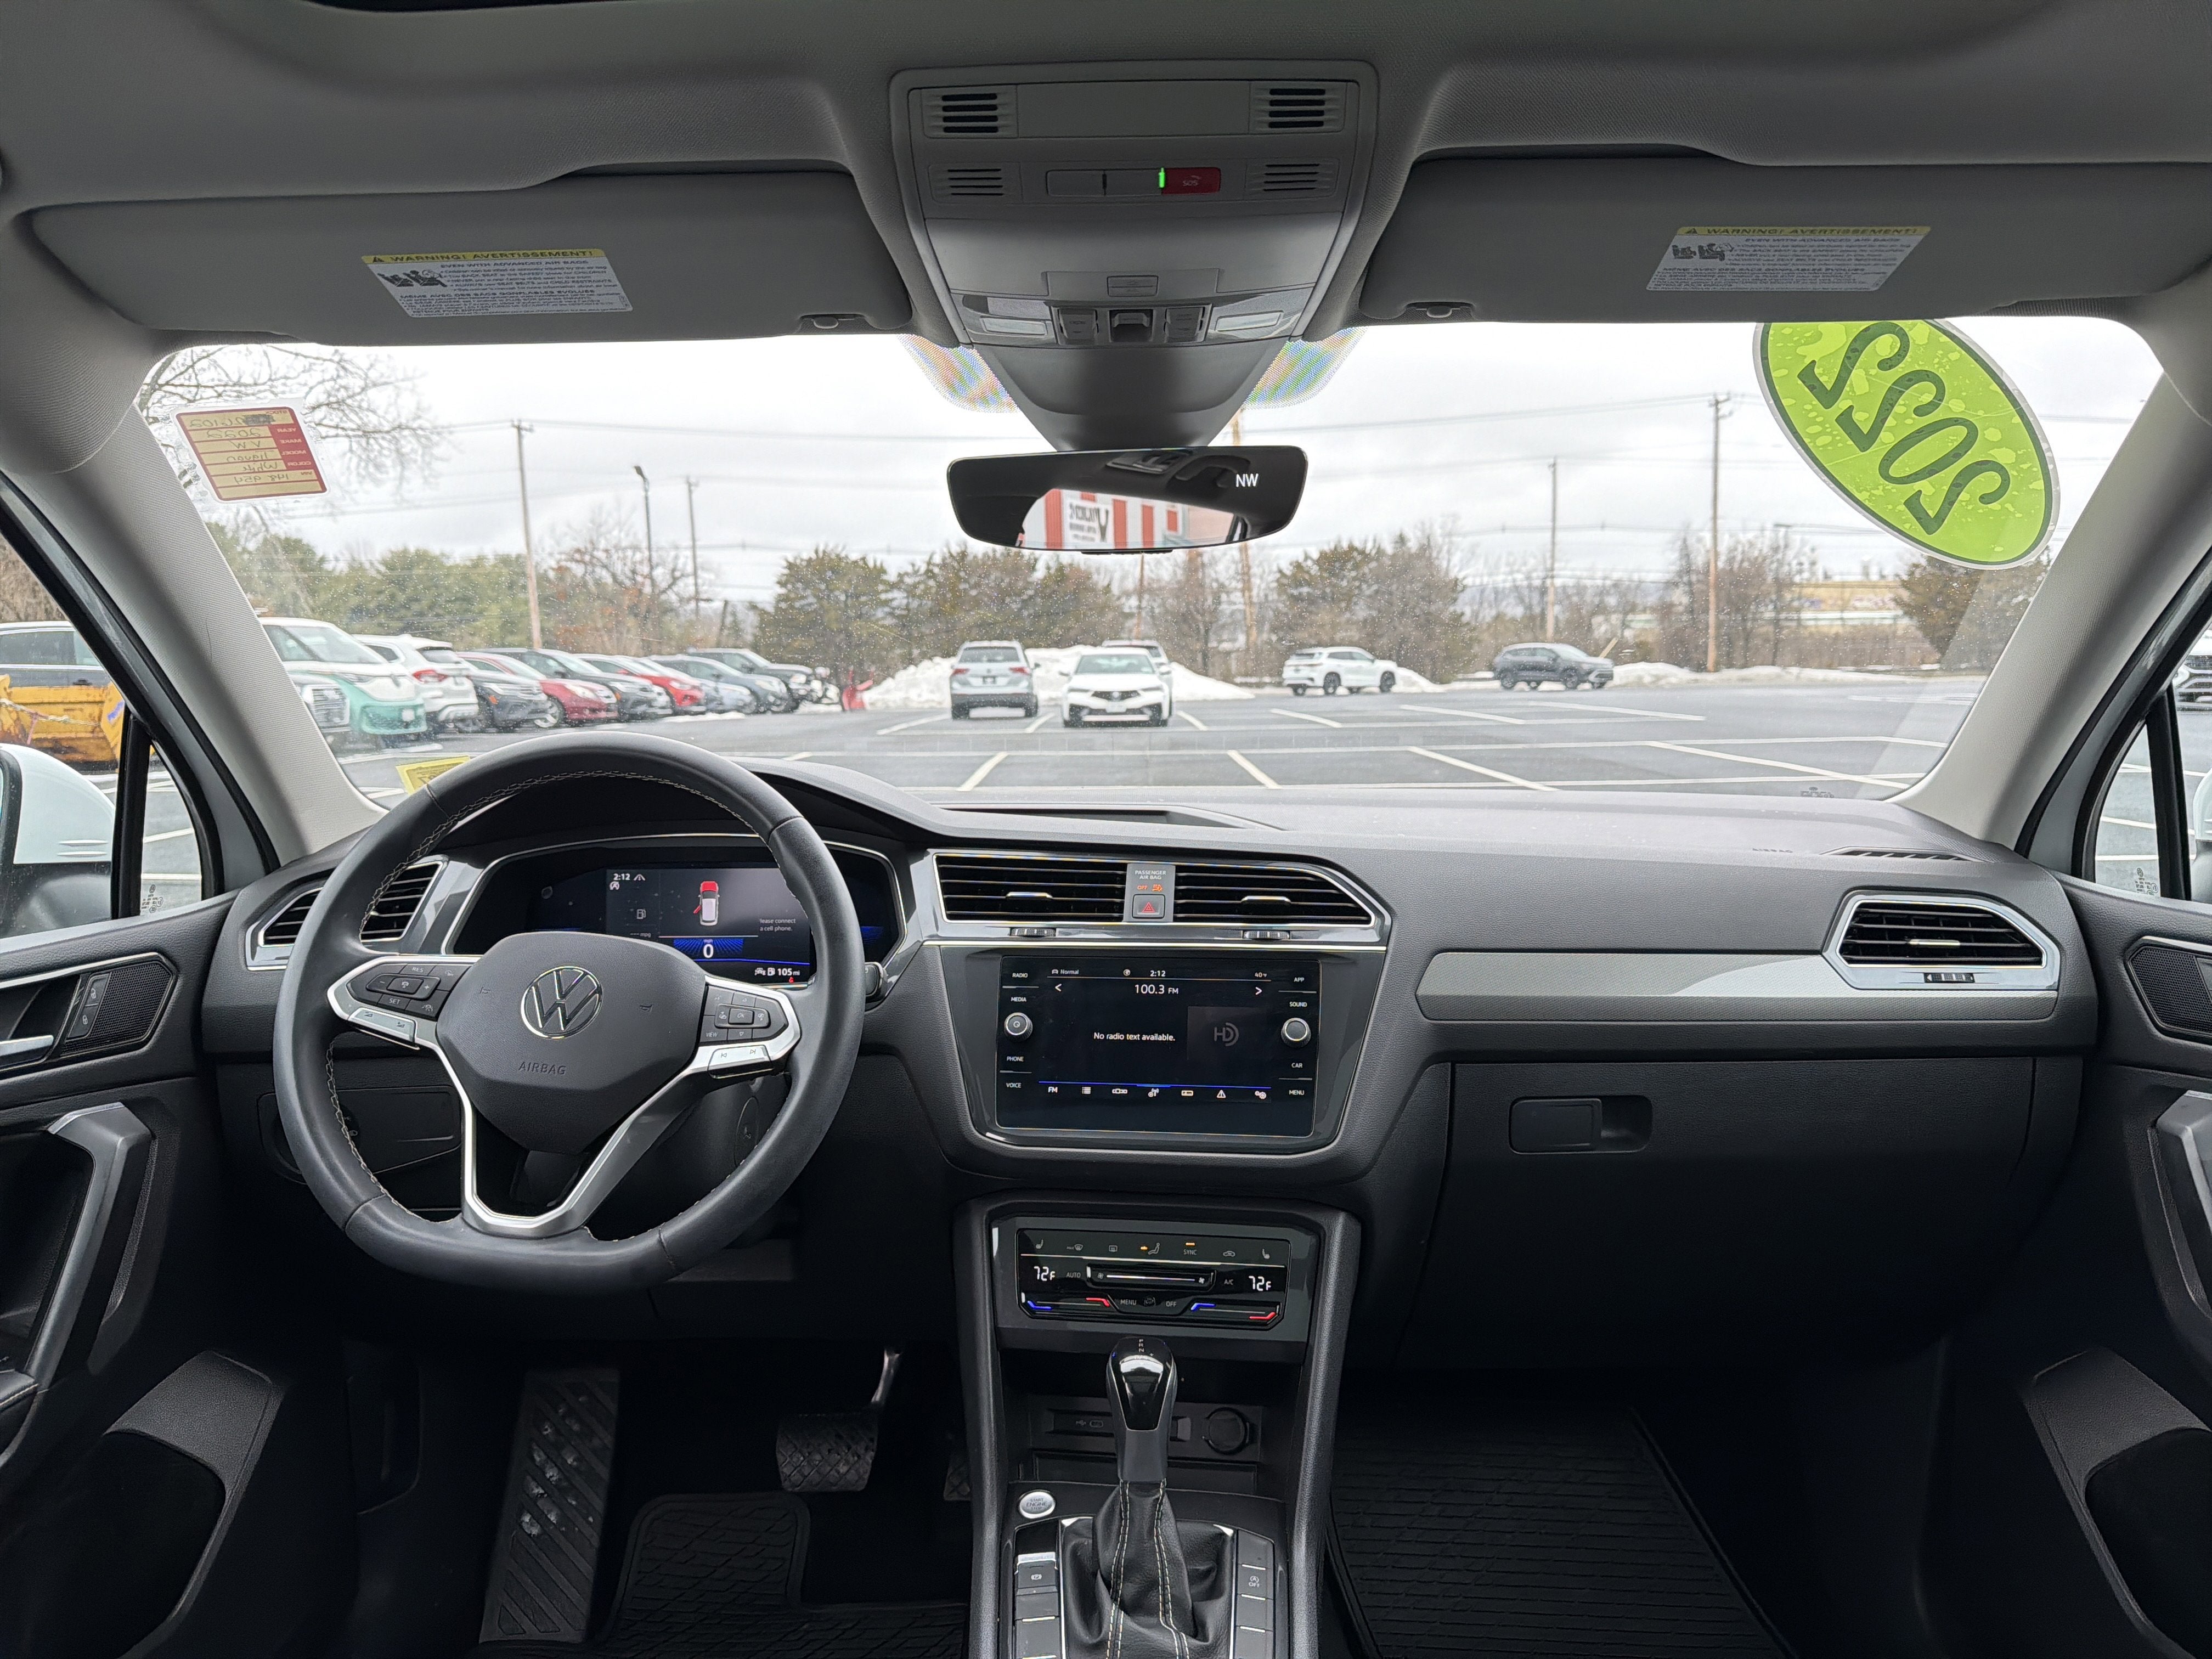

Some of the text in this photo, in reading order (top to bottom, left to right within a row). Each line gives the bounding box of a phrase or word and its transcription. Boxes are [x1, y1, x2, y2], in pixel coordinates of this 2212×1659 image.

[473, 251, 592, 260] AVERTISSEMENT!
[1235, 473, 1259, 487] NW
[703, 944, 714, 958] 0
[777, 968, 792, 976] 105
[1135, 984, 1165, 995] 100.3
[1093, 1032, 1176, 1042] No radio text available.
[518, 1061, 567, 1075] AIRBAG
